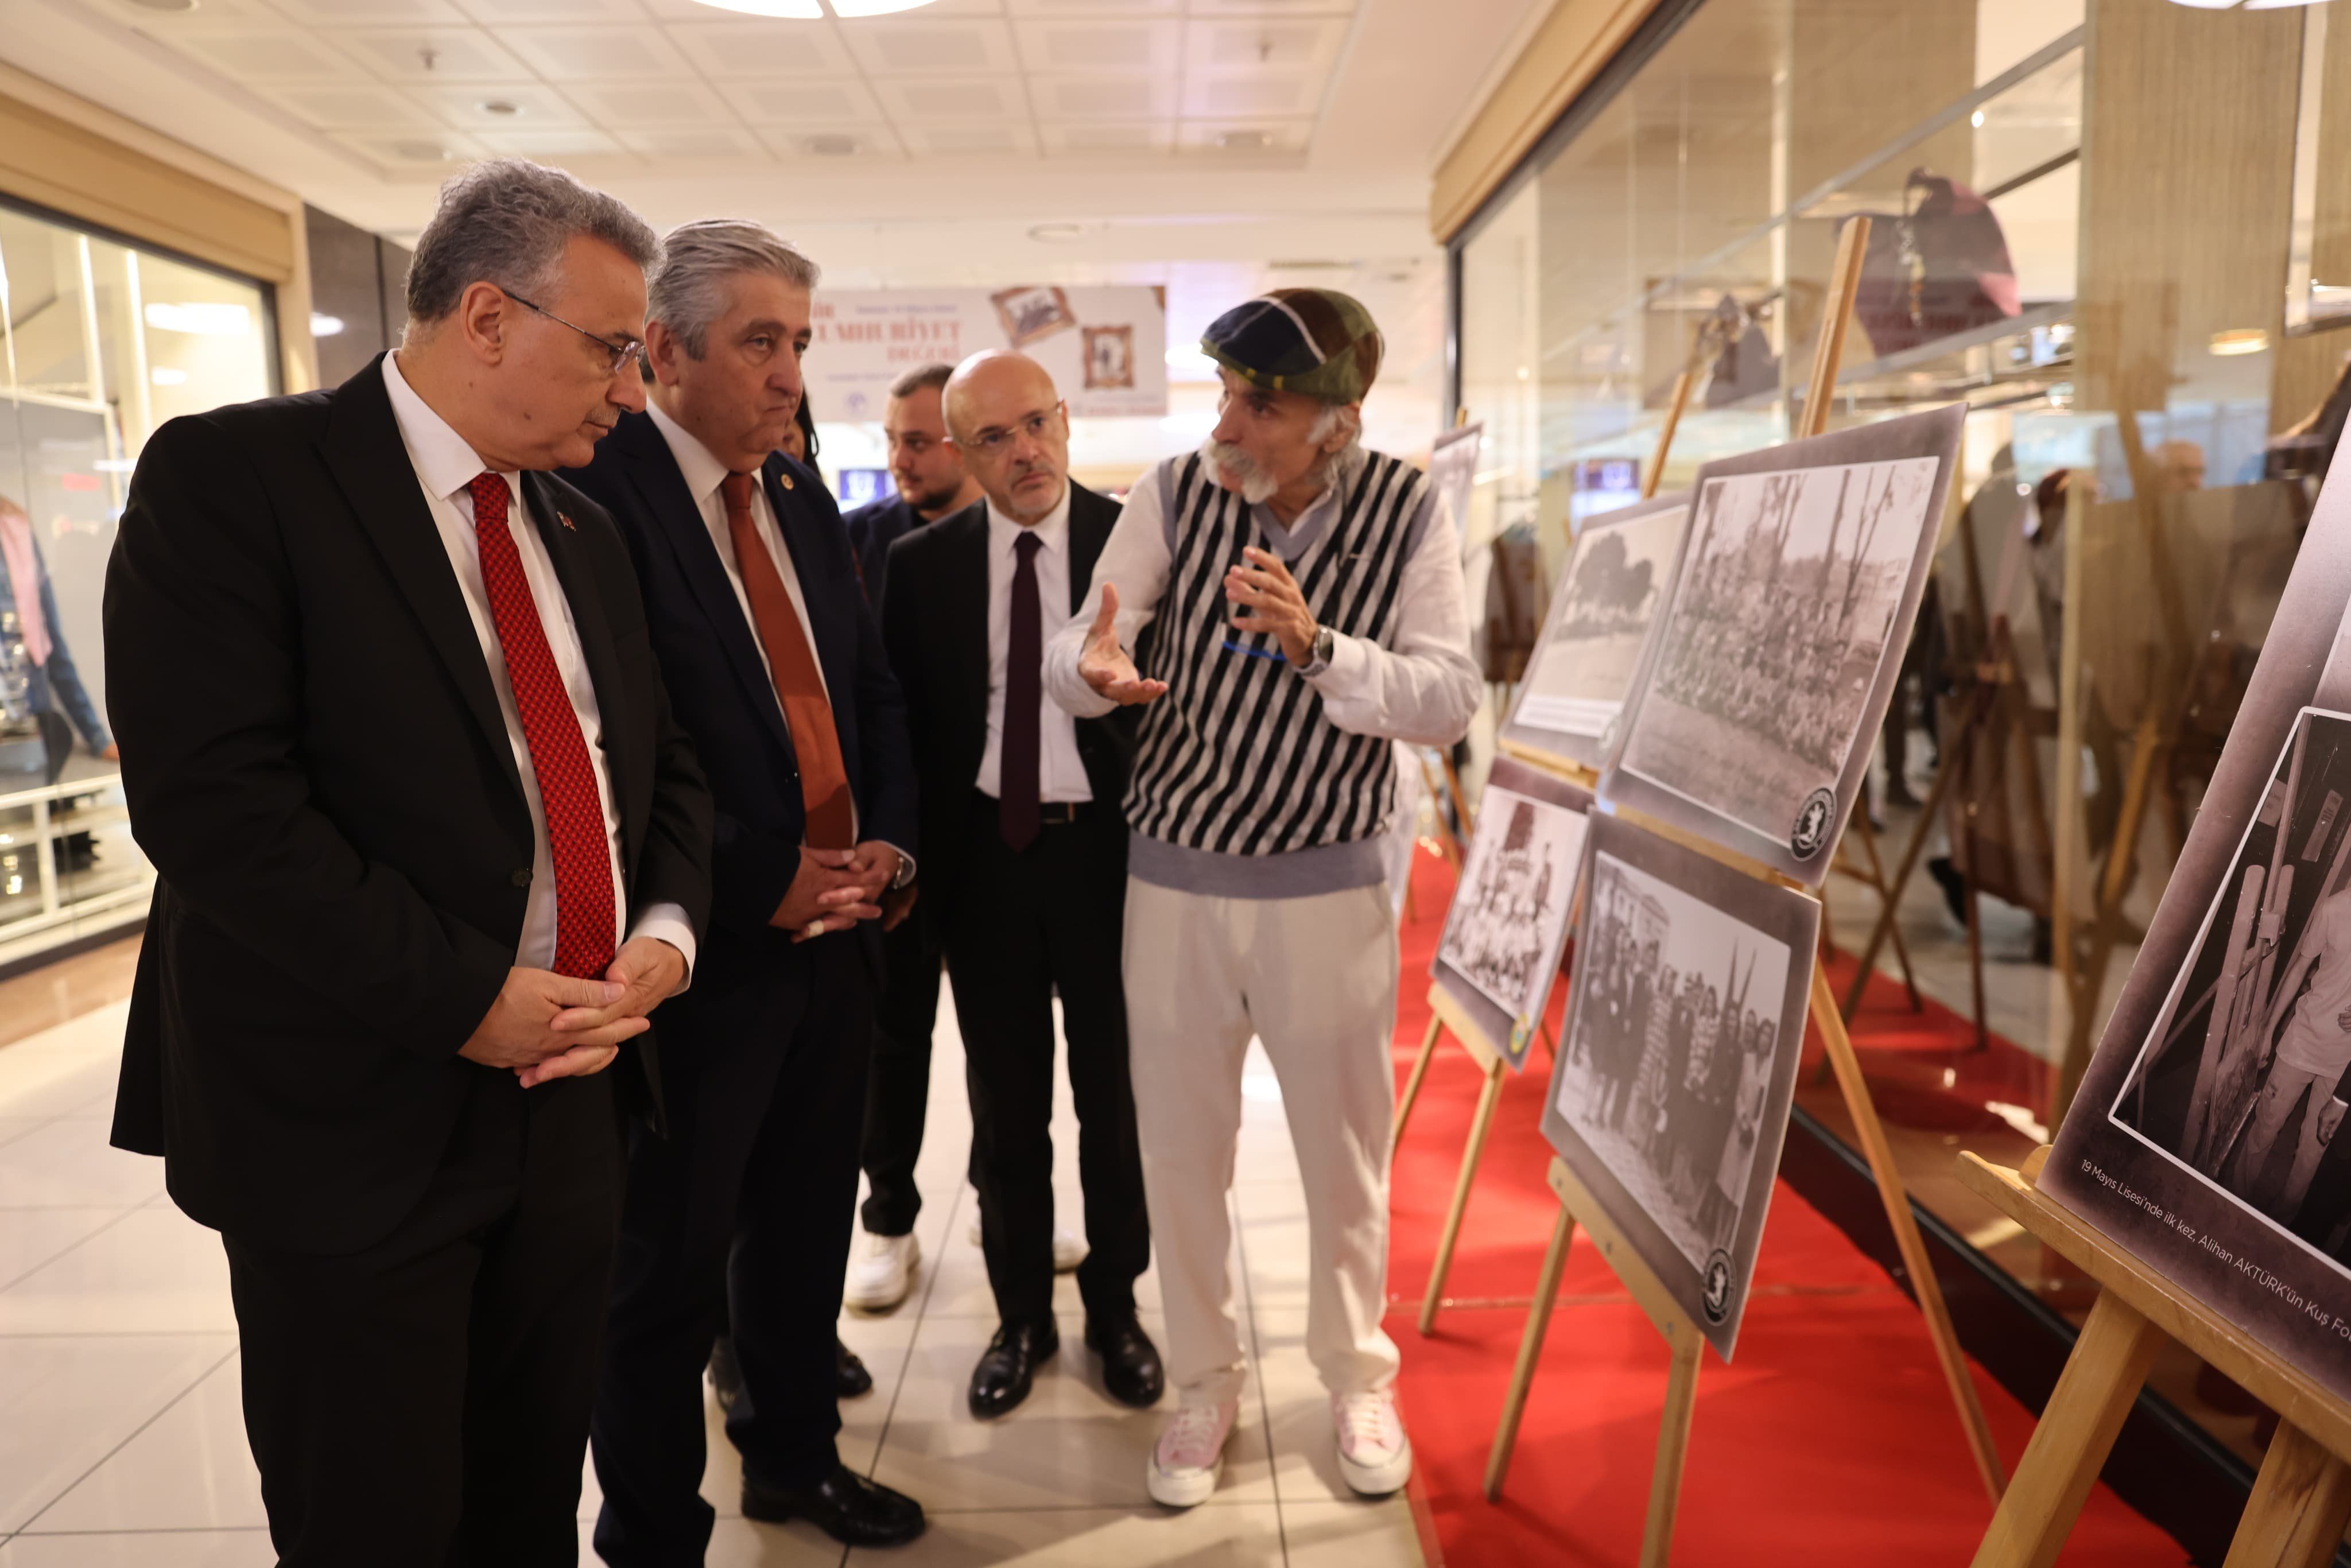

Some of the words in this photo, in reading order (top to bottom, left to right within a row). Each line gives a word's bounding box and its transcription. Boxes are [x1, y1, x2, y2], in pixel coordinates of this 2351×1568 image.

[815, 316, 961, 342] UMHURİYET
[2081, 1159, 2092, 1172] 19
[2092, 1166, 2117, 1189] Mayıs
[2117, 1182, 2163, 1218] Lisesi'nde
[2163, 1212, 2177, 1228] ilk
[2177, 1219, 2196, 1243] kez,
[2198, 1235, 2233, 1264] Alihan
[2233, 1257, 2303, 1309] AKTÜRK'ün
[2305, 1301, 2330, 1326] Kuş
